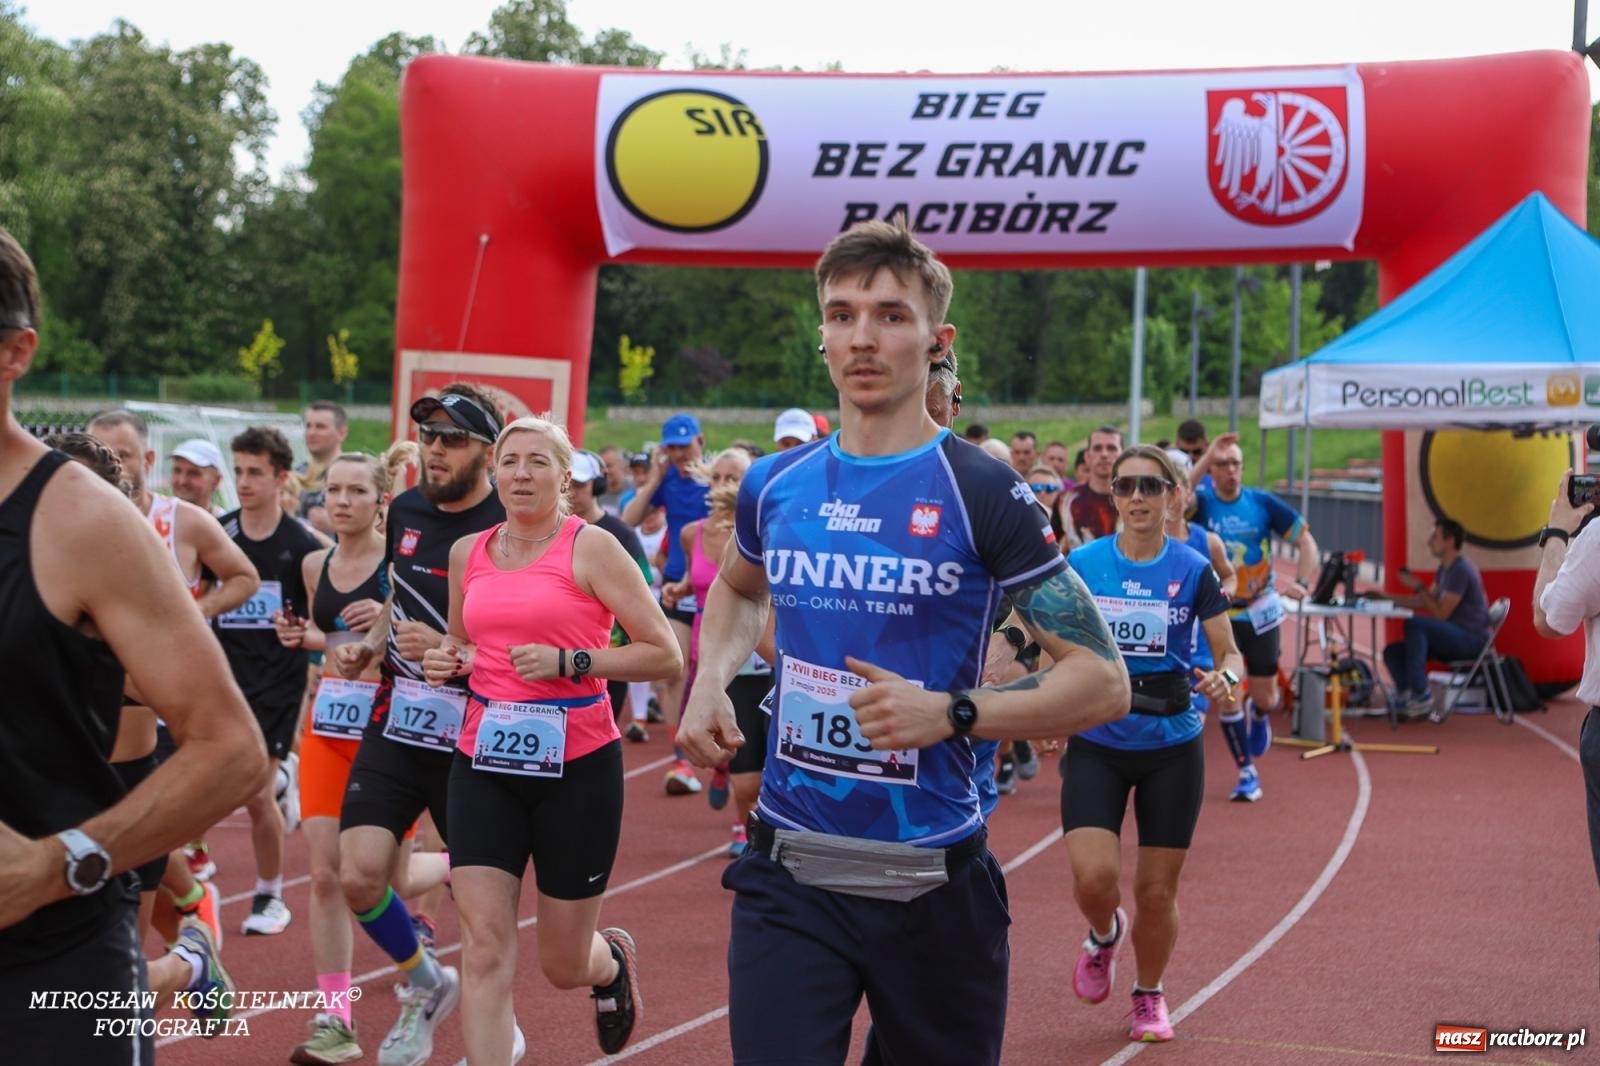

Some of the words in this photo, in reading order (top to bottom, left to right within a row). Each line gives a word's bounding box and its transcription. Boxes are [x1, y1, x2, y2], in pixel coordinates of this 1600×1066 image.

[911, 92, 1046, 119] BIEG
[684, 106, 765, 138] SIR
[812, 142, 926, 177] BEZ
[936, 140, 1146, 177] GRANIC
[1342, 377, 1533, 408] PersonalBest
[762, 549, 965, 596] UNNERS
[865, 600, 914, 616] TEAM
[1108, 621, 1146, 641] 180
[792, 662, 810, 676] XVII
[812, 668, 838, 683] BIEG
[840, 674, 862, 687] BEZ
[795, 681, 815, 693] maja
[816, 686, 837, 697] 2025
[328, 702, 361, 723] 170
[404, 706, 438, 731] 172
[513, 704, 527, 713] BEZ
[492, 729, 540, 756] 229
